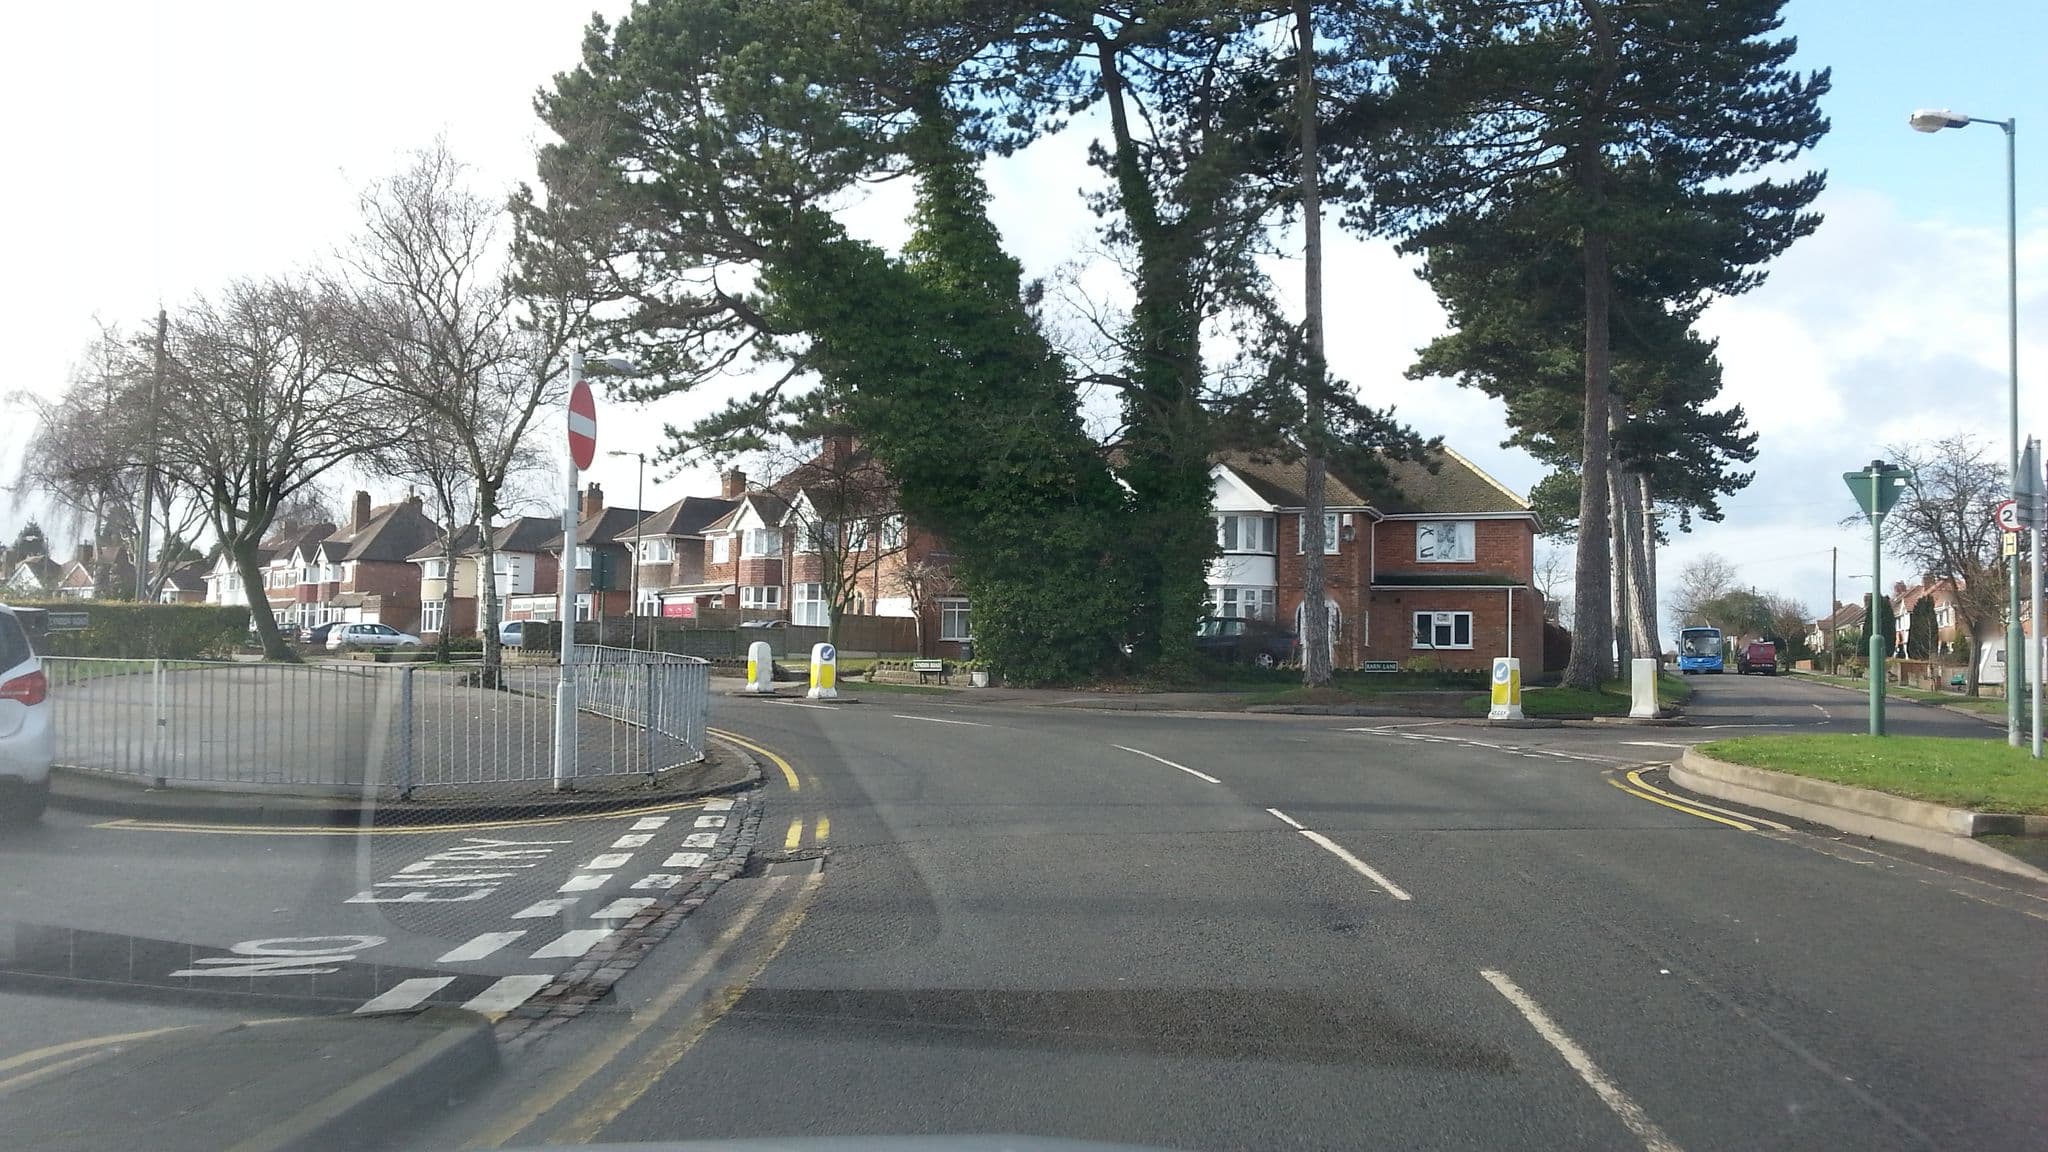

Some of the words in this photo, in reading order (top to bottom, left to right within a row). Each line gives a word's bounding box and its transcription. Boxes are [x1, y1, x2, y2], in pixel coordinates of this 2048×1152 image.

[2003, 510, 2012, 522] 2
[2005, 536, 2014, 553] H
[72, 617, 88, 625] ROAD
[343, 837, 573, 904] ENTRY
[168, 935, 388, 978] NO
